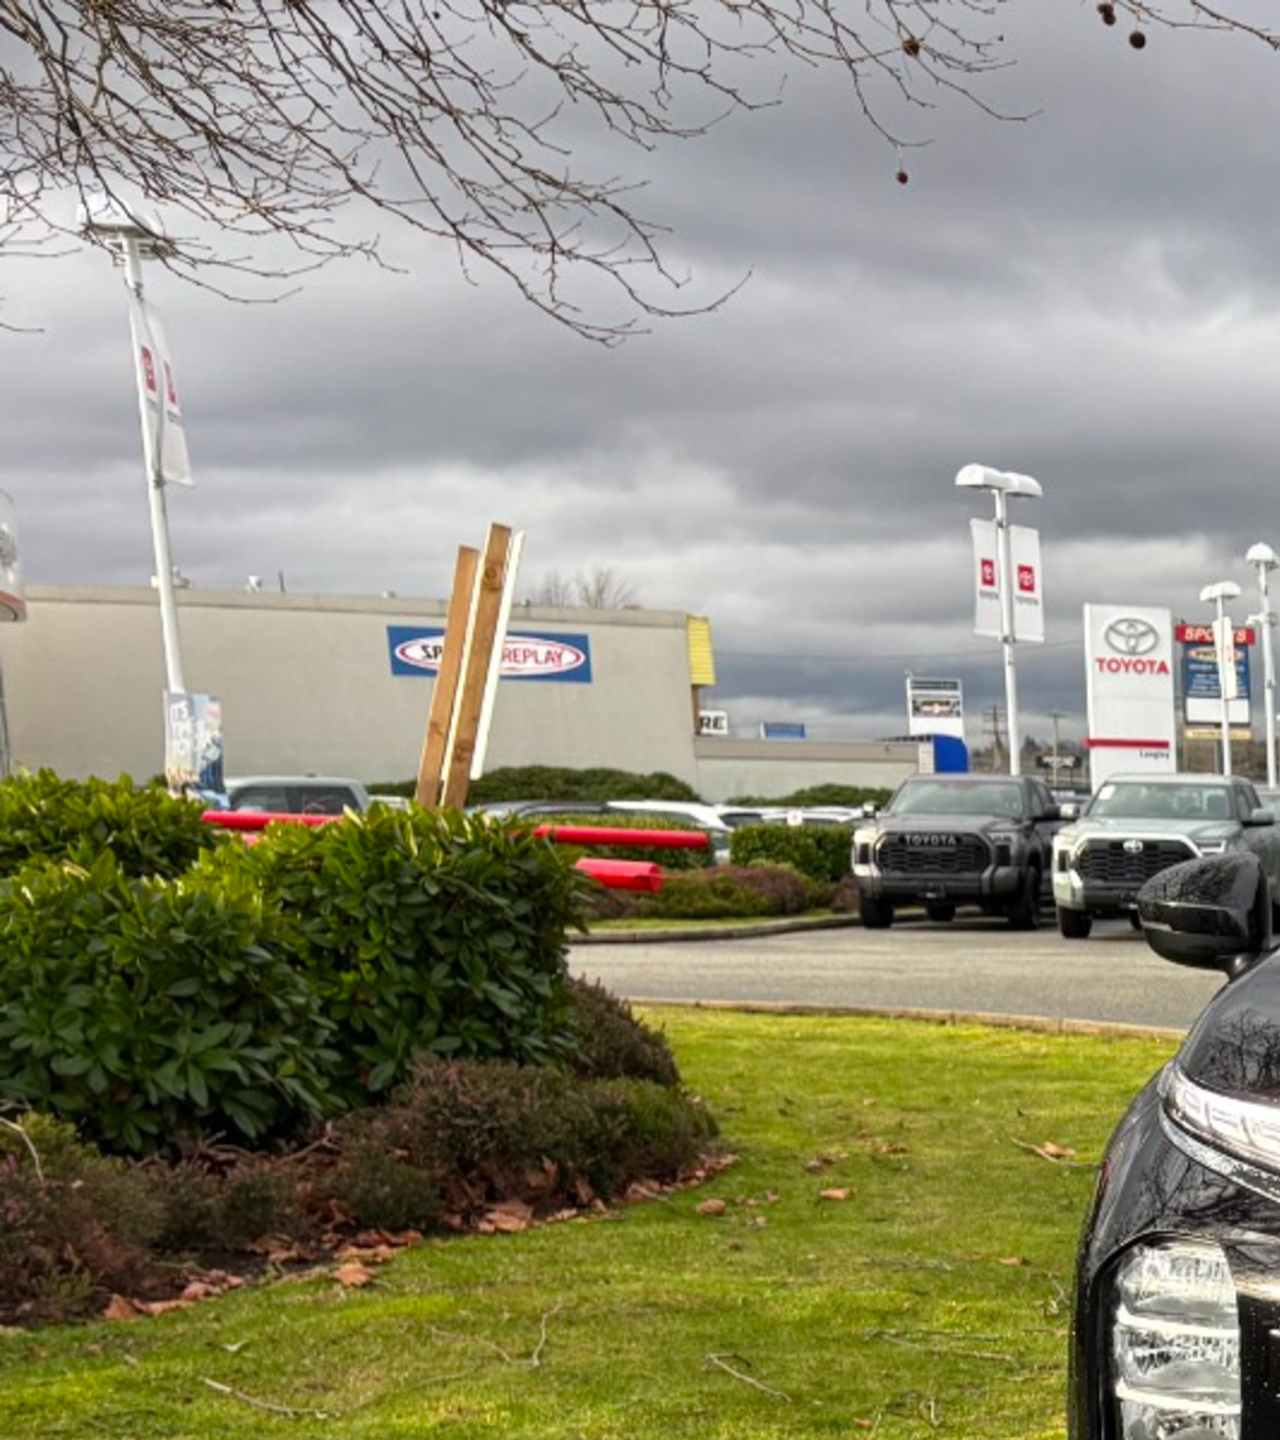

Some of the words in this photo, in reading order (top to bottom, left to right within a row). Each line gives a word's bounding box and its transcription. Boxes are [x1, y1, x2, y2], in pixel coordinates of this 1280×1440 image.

[1184, 627, 1247, 643] SPOS
[501, 647, 563, 666] REPLAY
[1096, 658, 1170, 674] TOYOTA
[904, 834, 957, 847] TOYOTA
